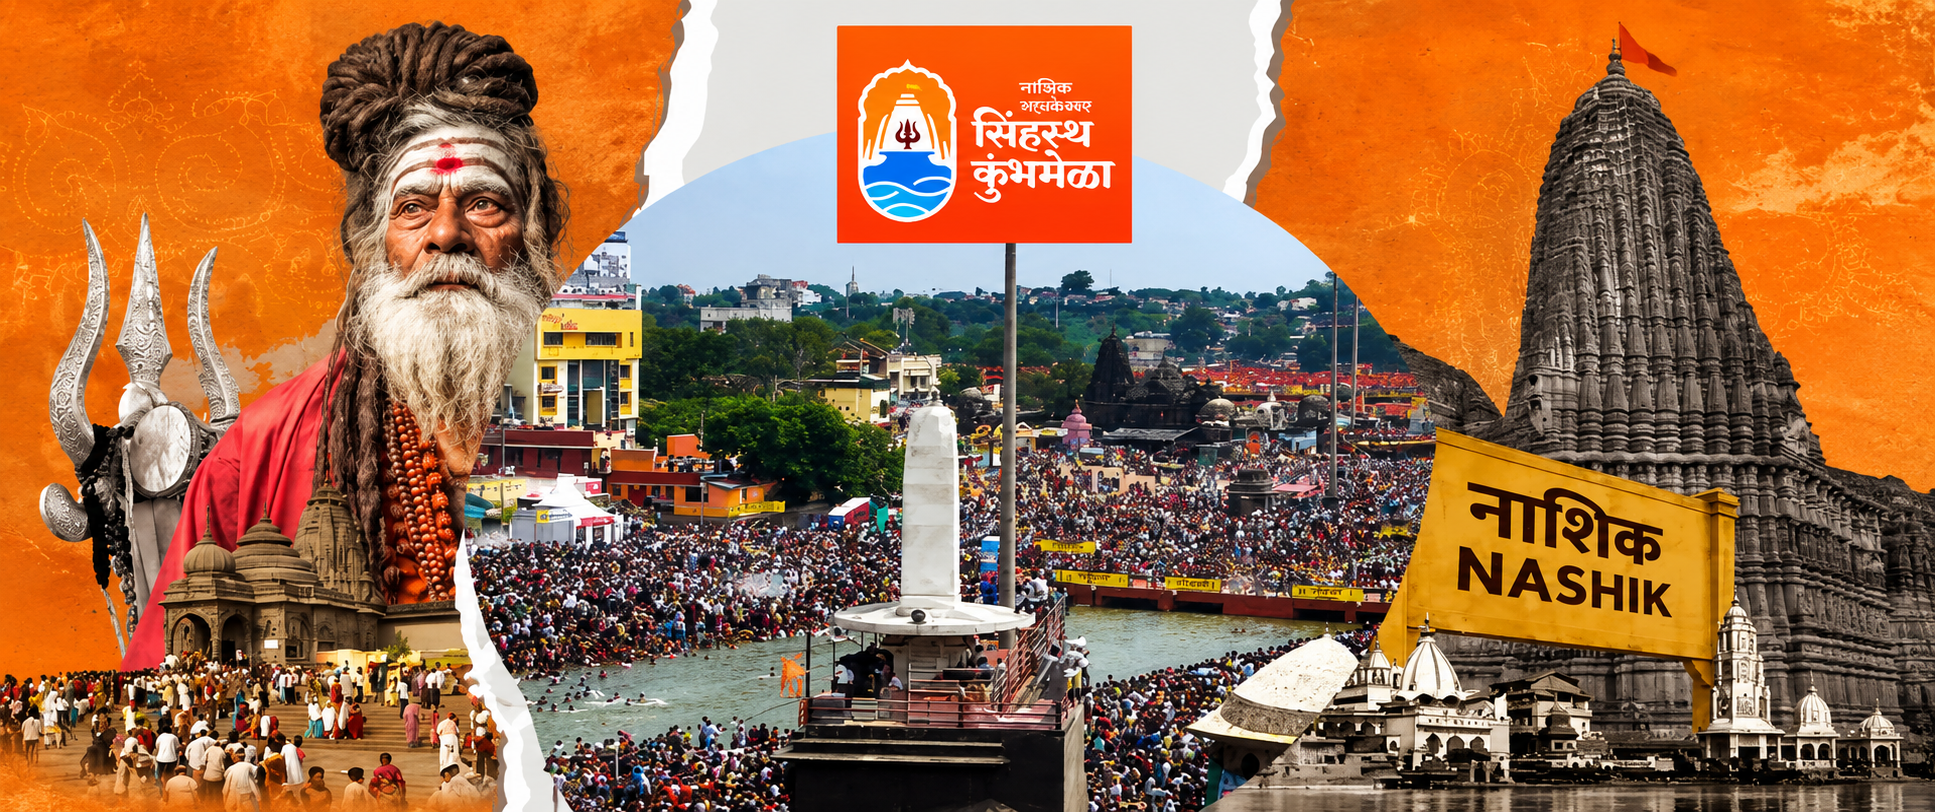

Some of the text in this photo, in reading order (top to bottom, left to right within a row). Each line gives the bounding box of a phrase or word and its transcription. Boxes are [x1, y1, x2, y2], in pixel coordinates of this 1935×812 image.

[970, 106, 1095, 152] सिंहस्थ
[970, 150, 1116, 204] कुंभमेळा
[1467, 481, 1664, 566] नाशिक
[1457, 545, 1673, 618] NASHIK
